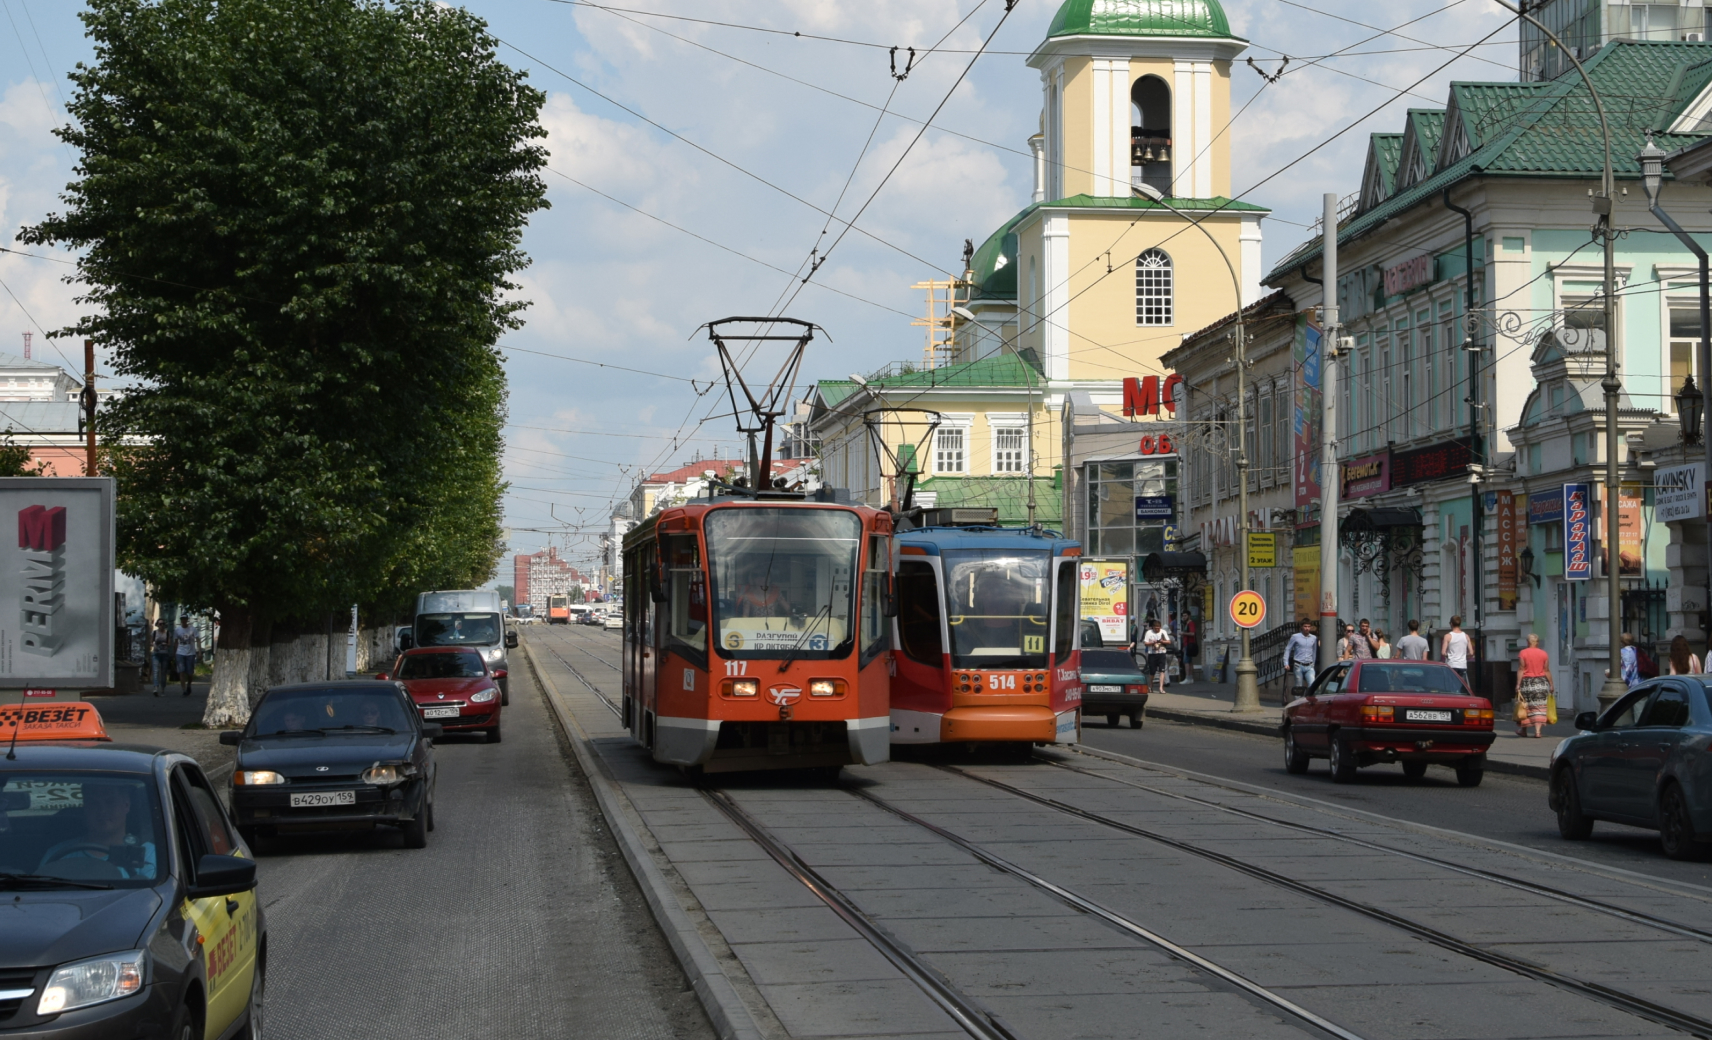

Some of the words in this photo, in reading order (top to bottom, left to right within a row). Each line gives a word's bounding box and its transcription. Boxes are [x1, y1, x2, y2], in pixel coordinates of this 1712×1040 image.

[1655, 468, 1696, 496] KAVINSKY
[1501, 495, 1512, 566] МАССАЖ
[1238, 601, 1258, 616] 20
[728, 634, 740, 649] 3
[813, 638, 825, 651] 3
[1028, 637, 1040, 651] 11
[724, 660, 748, 676] 117
[989, 674, 1016, 690] 514
[24, 707, 90, 724] ВЕЗЁТ
[22, 721, 53, 730] ЗАКАЗА
[55, 721, 82, 729] ТАКСИ
[294, 795, 335, 806] В429ОУ
[337, 792, 353, 801] 159
